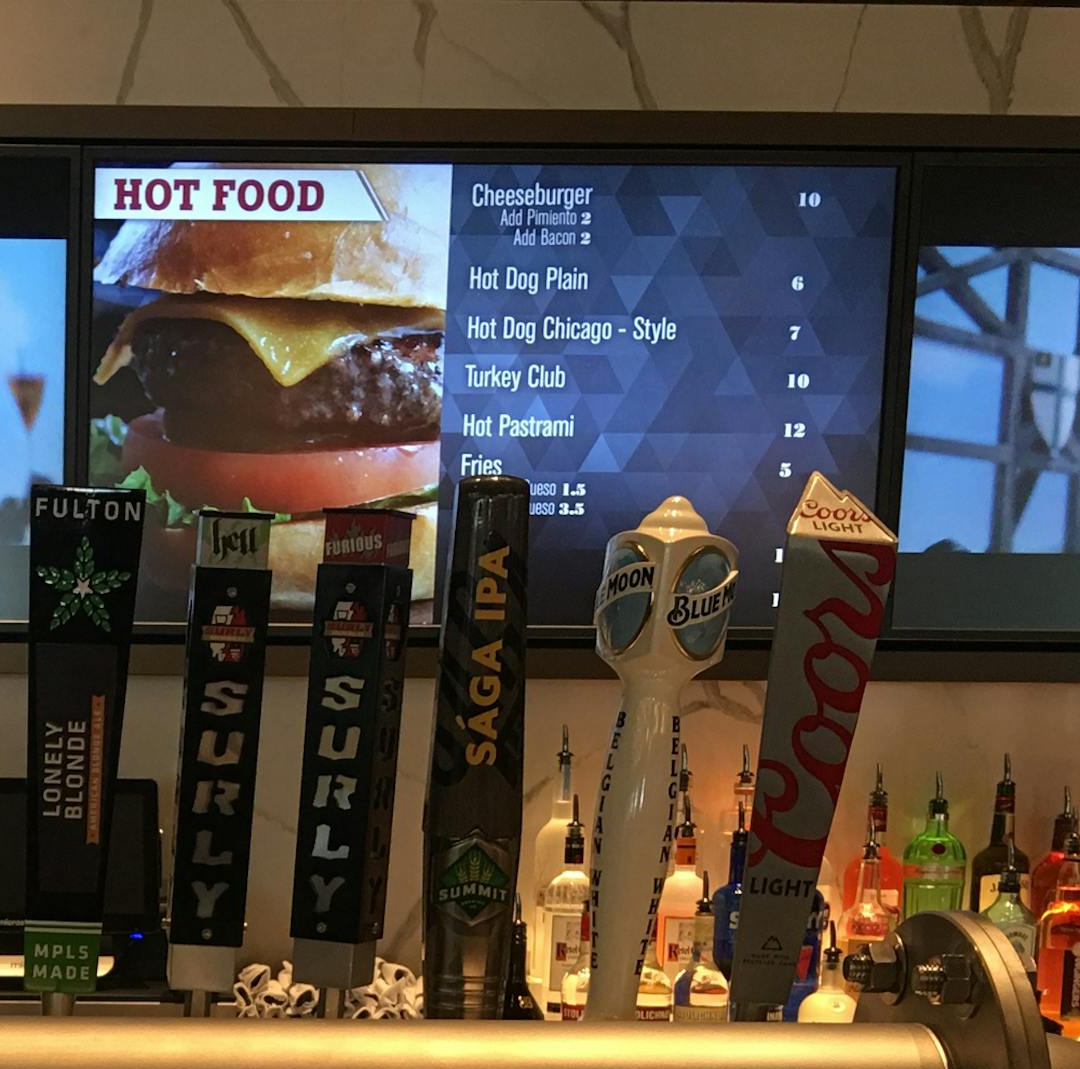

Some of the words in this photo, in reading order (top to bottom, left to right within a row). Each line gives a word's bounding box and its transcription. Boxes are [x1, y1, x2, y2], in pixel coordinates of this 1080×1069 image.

[114, 178, 200, 211] HOT
[212, 179, 325, 212] FOOD
[472, 182, 593, 209] Cheeseburger
[798, 192, 821, 208] 10
[500, 208, 523, 226] Add
[527, 208, 578, 226] Pimiento
[580, 211, 592, 225] 2
[513, 228, 536, 246] Add
[541, 228, 576, 246] Bacon
[580, 232, 592, 245] 2
[469, 266, 499, 290] Hot
[505, 267, 539, 295] Dog
[546, 267, 589, 290] Plain
[791, 275, 804, 291] 6
[467, 316, 496, 340] Hot
[503, 316, 536, 344] Dog
[543, 316, 612, 344] Chicago
[633, 316, 677, 344] Style
[788, 325, 801, 341] 7
[465, 364, 521, 392] Turkey
[527, 364, 566, 388] Club
[787, 372, 810, 388] 10
[463, 414, 492, 437] Hot
[499, 414, 575, 437] Pastrami
[783, 422, 806, 438] 12
[461, 454, 502, 477] Fries
[778, 462, 792, 478] 5
[527, 481, 557, 496] ueso
[562, 482, 587, 497] 1.5
[35, 497, 141, 521] FULTON
[528, 502, 556, 516] ueso
[558, 502, 586, 516] 3.5
[800, 499, 872, 522] Coors
[812, 520, 864, 534] LIGHT
[325, 533, 383, 557] FURIOUS
[474, 545, 511, 622] IPA
[606, 566, 655, 600] MOON
[667, 593, 721, 627] BLUE
[748, 540, 897, 869] Coors
[42, 721, 64, 817] LONELY
[65, 720, 87, 819] BLONDE
[190, 679, 249, 919] SURLY
[310, 675, 366, 913] SURLY
[660, 715, 681, 864] BELGIAN
[438, 882, 508, 902] SUMMIT
[749, 875, 814, 899] LIGHT
[34, 943, 89, 960] MPLS
[32, 963, 90, 980] MADE
